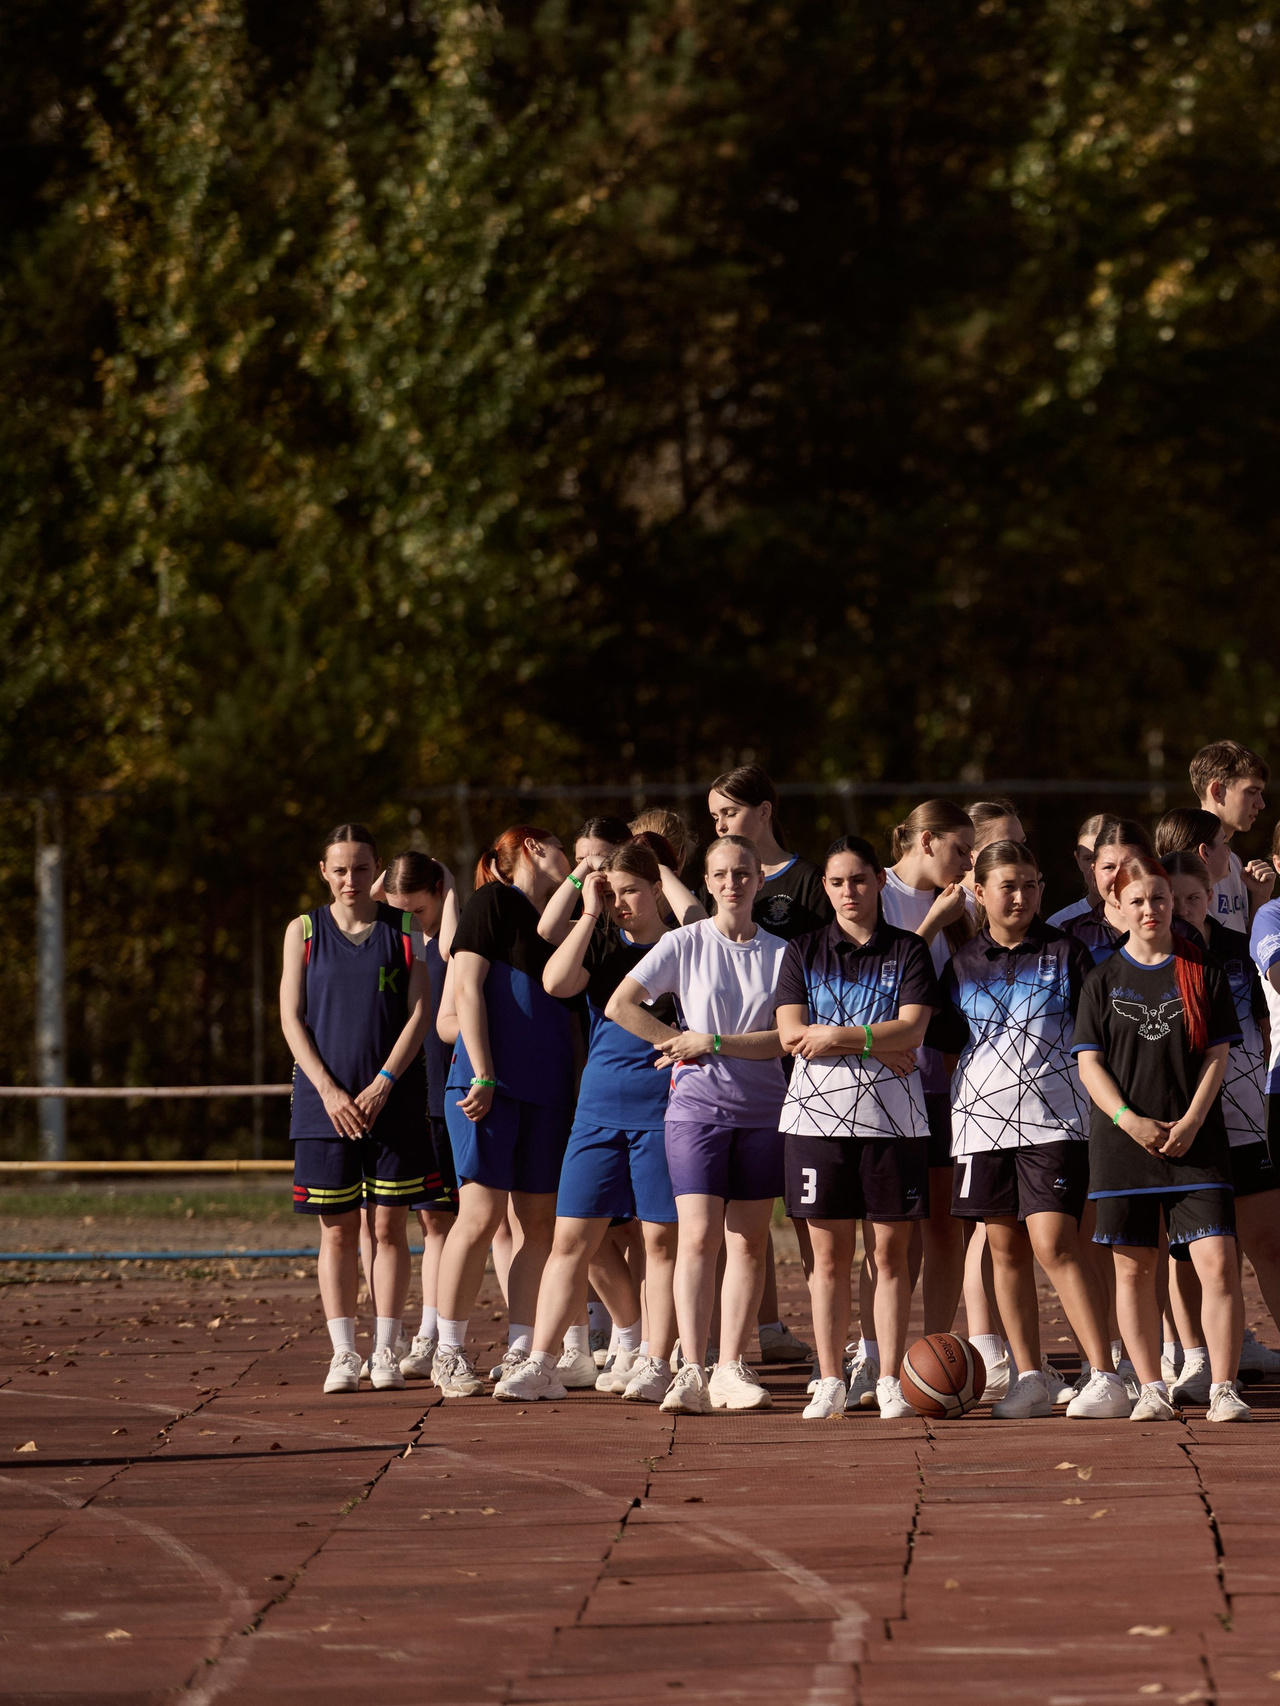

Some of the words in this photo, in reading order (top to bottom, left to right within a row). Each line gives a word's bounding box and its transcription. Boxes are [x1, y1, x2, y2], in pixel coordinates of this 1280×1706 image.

[800, 1167, 818, 1205] 3
[957, 1155, 973, 1199] 7
[934, 1335, 958, 1364] molten
